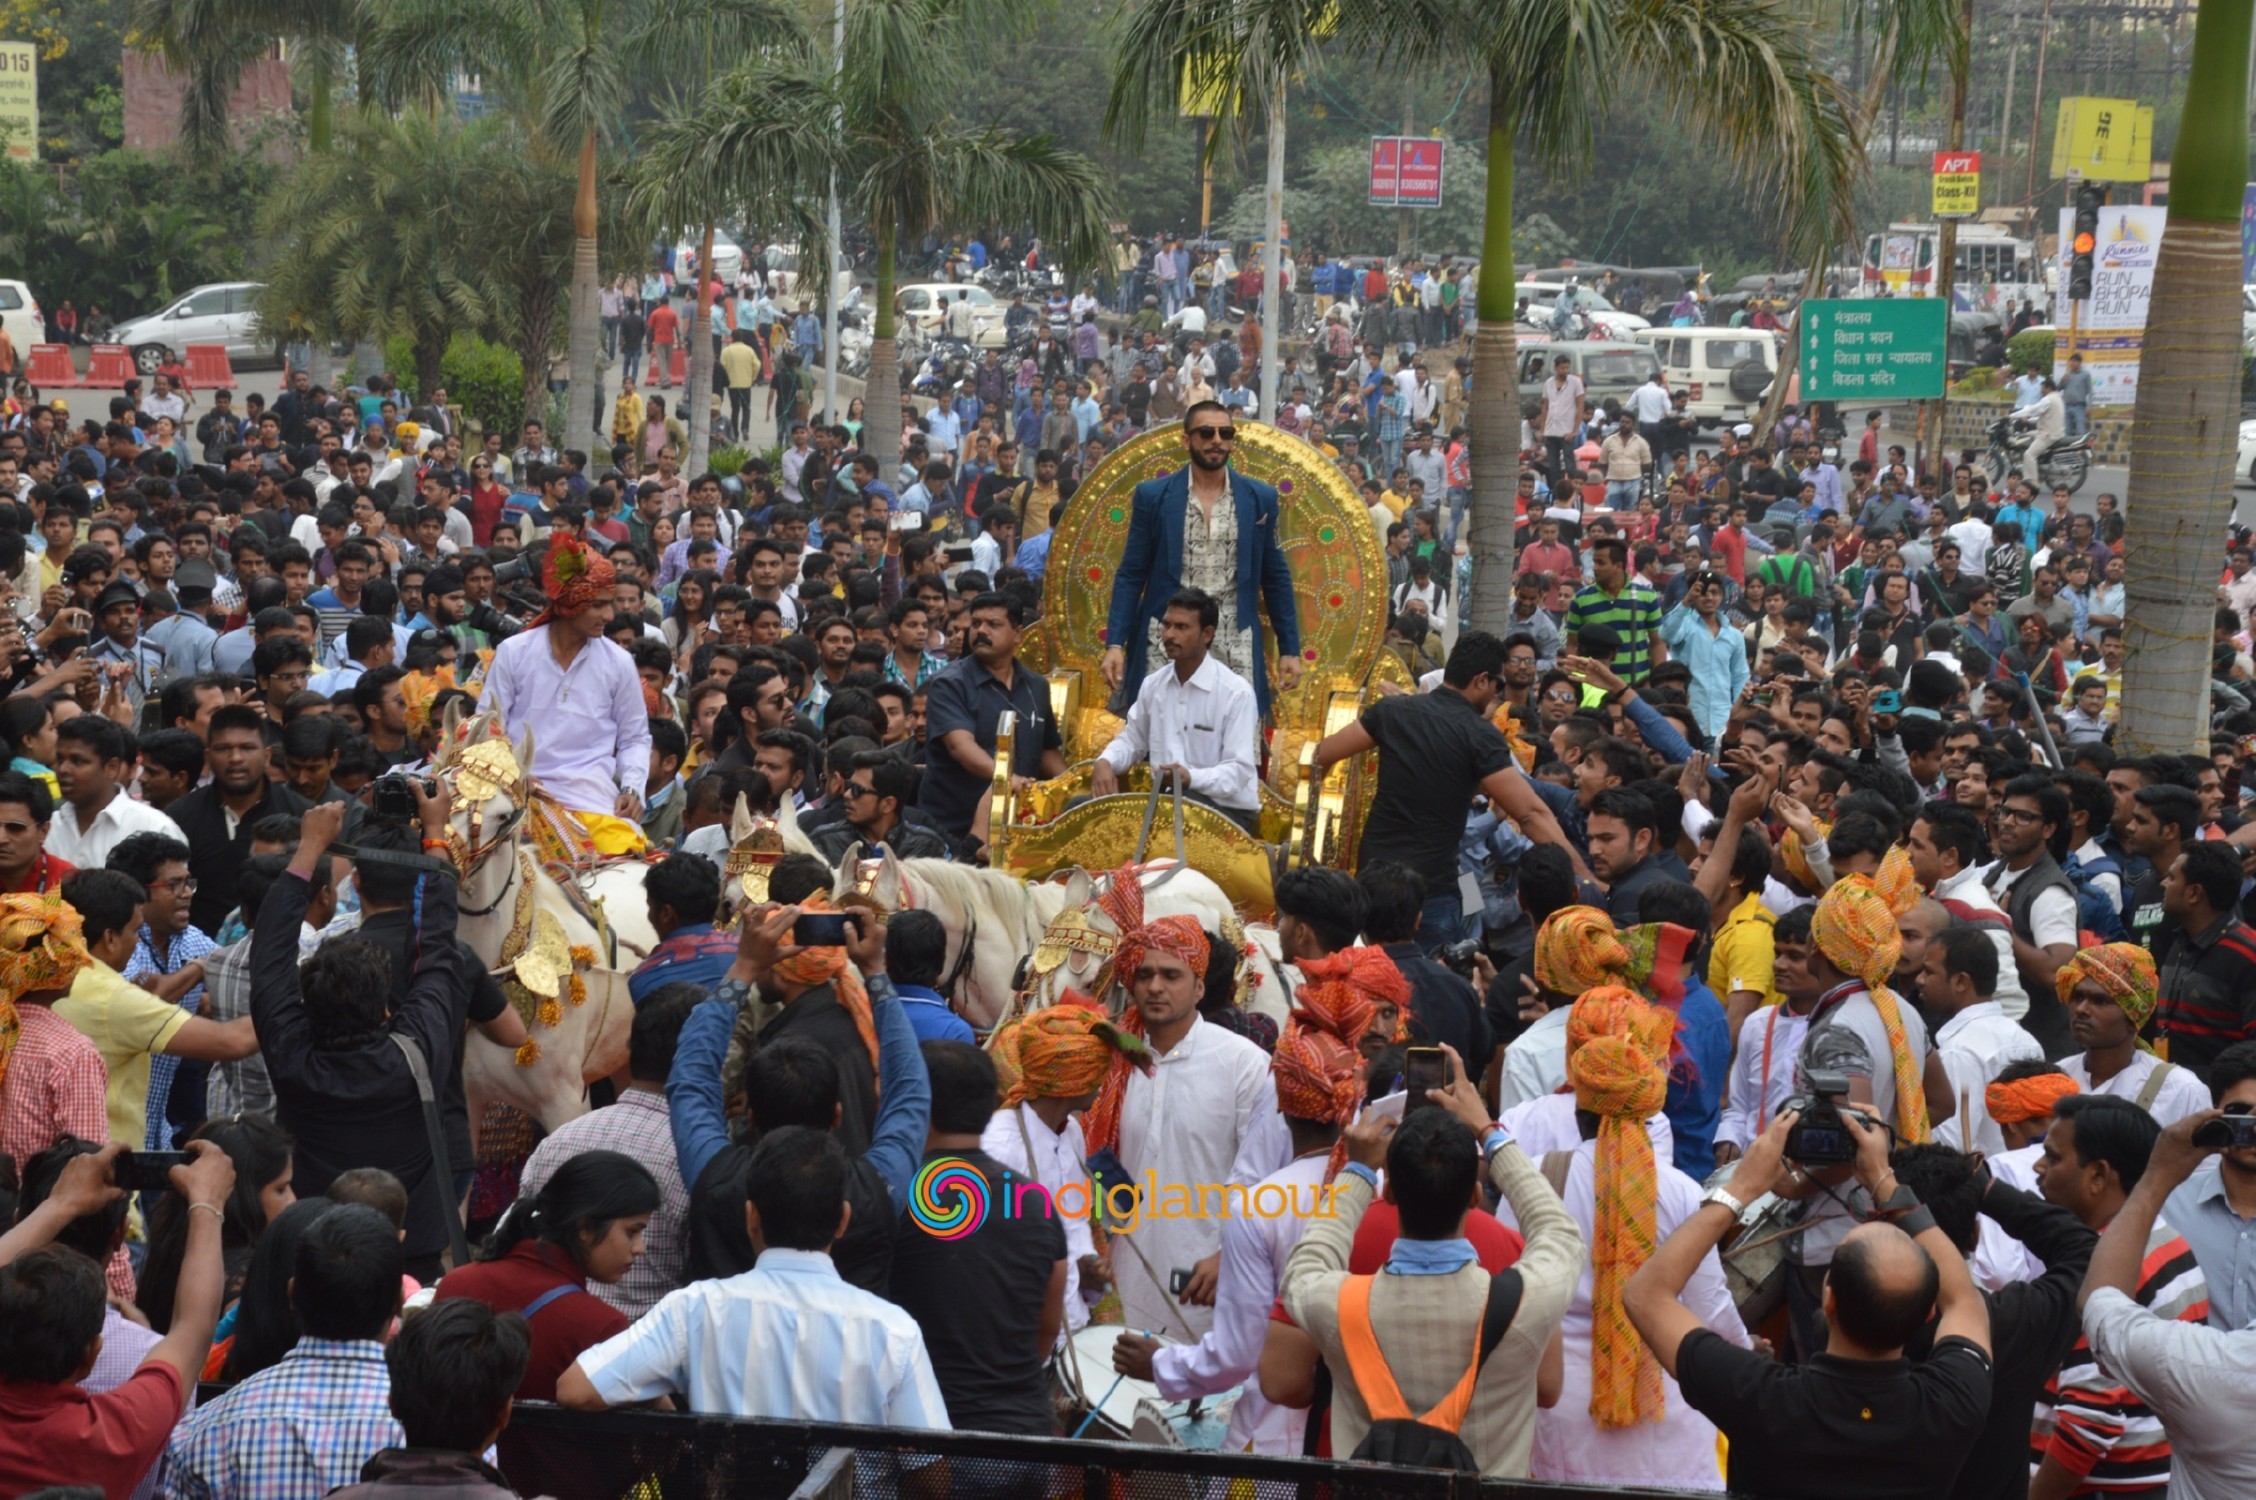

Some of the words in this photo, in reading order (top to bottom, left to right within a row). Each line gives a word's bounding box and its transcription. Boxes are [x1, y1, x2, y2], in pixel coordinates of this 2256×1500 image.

[1942, 157, 1973, 172] APT
[2096, 271, 2133, 285] RUN
[2094, 301, 2131, 315] RUN
[1834, 310, 1872, 324] मंत्रालय
[1834, 328, 1864, 344] विधान
[1869, 331, 1893, 344] भवन
[1834, 348, 1861, 365] जिला
[1888, 351, 1933, 364] न्यायालय
[1869, 369, 1896, 385] मंदिर
